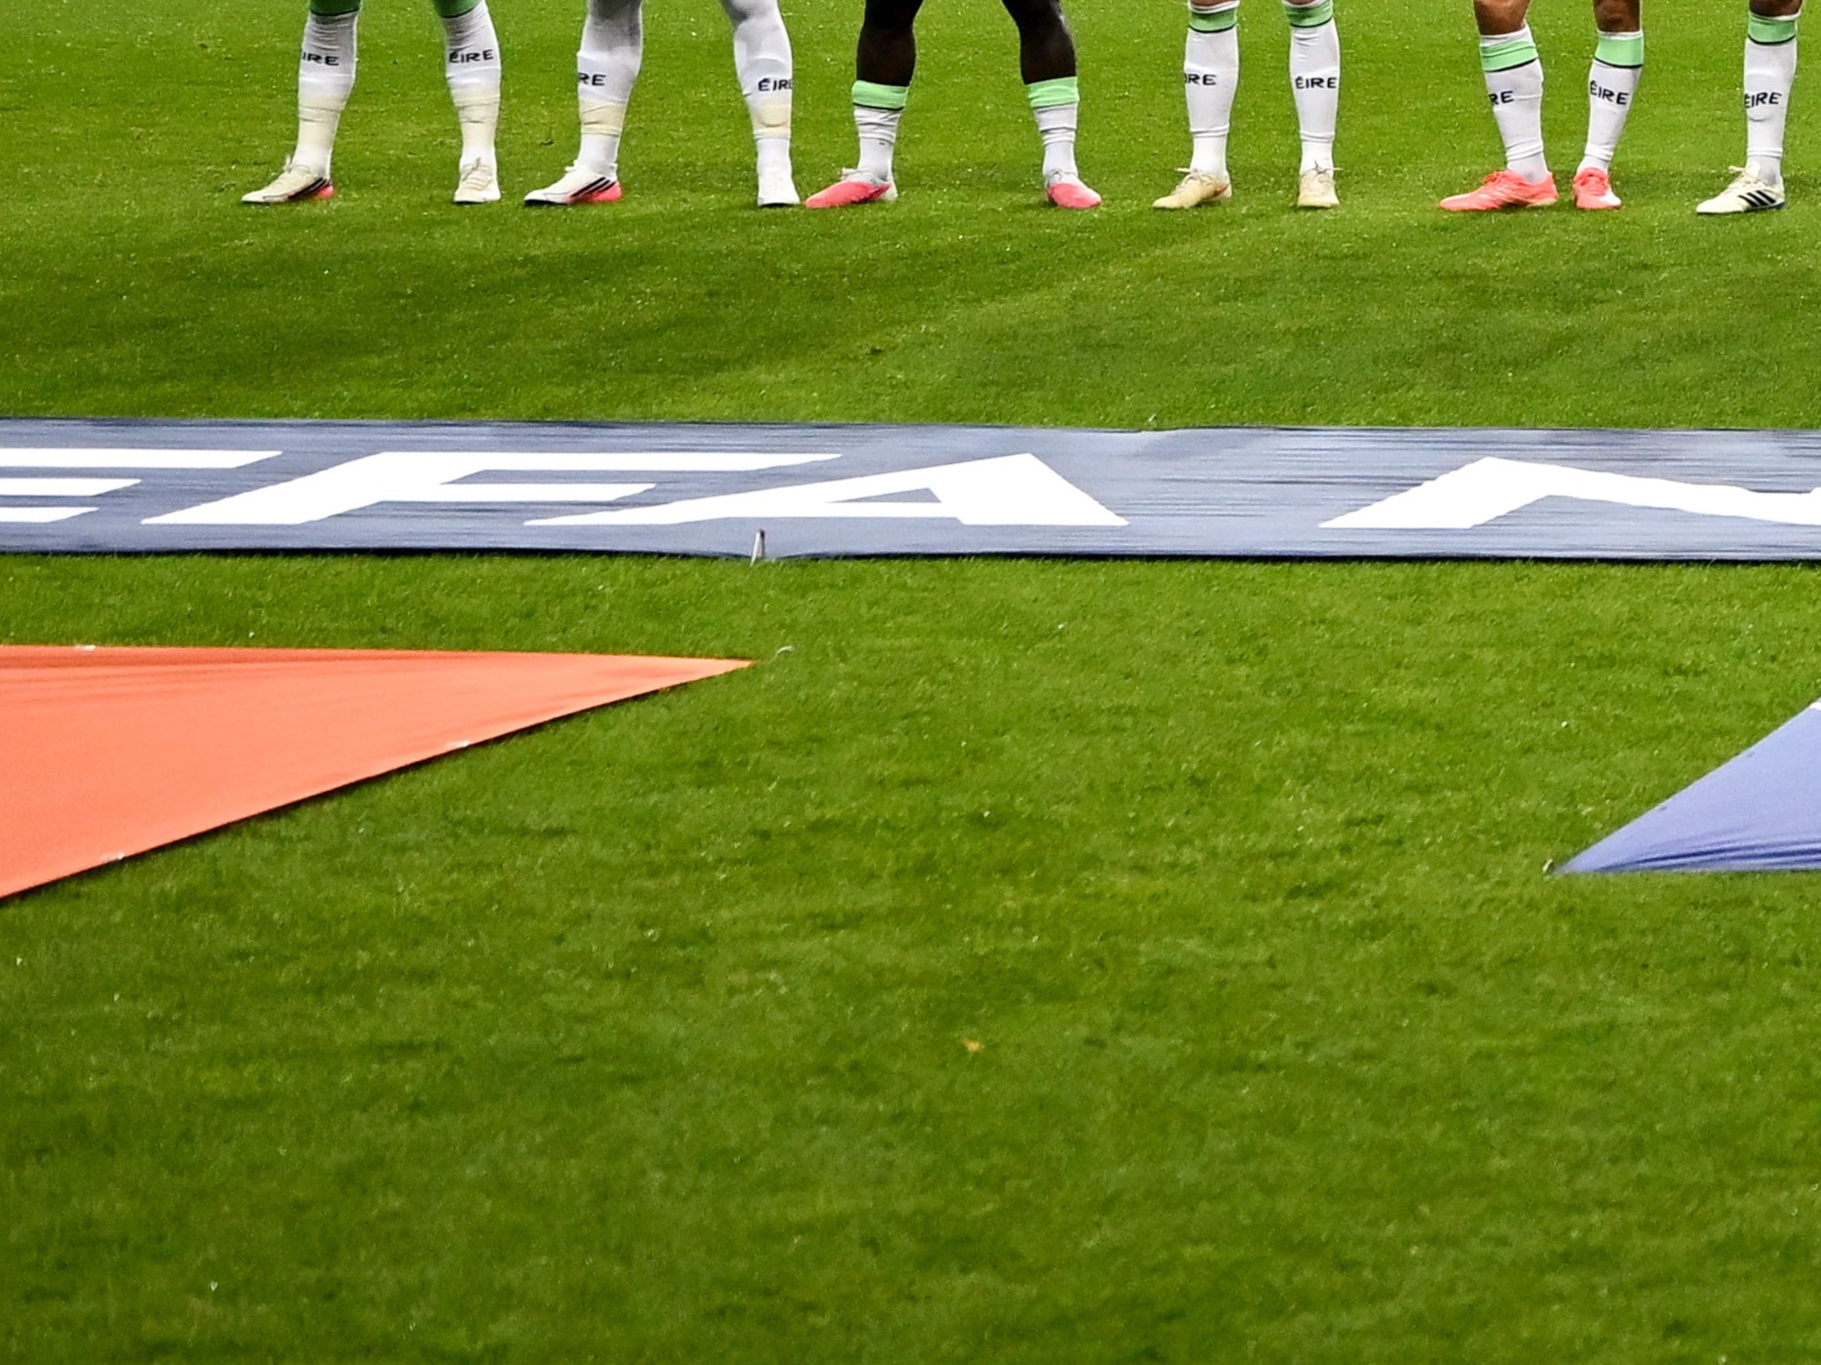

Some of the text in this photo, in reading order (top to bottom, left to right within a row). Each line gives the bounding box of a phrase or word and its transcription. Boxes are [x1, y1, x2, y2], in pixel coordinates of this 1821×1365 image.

[302, 52, 340, 66] IRE
[578, 72, 607, 86] RE
[1295, 76, 1337, 89] ÉIRE
[1488, 90, 1514, 105] RE
